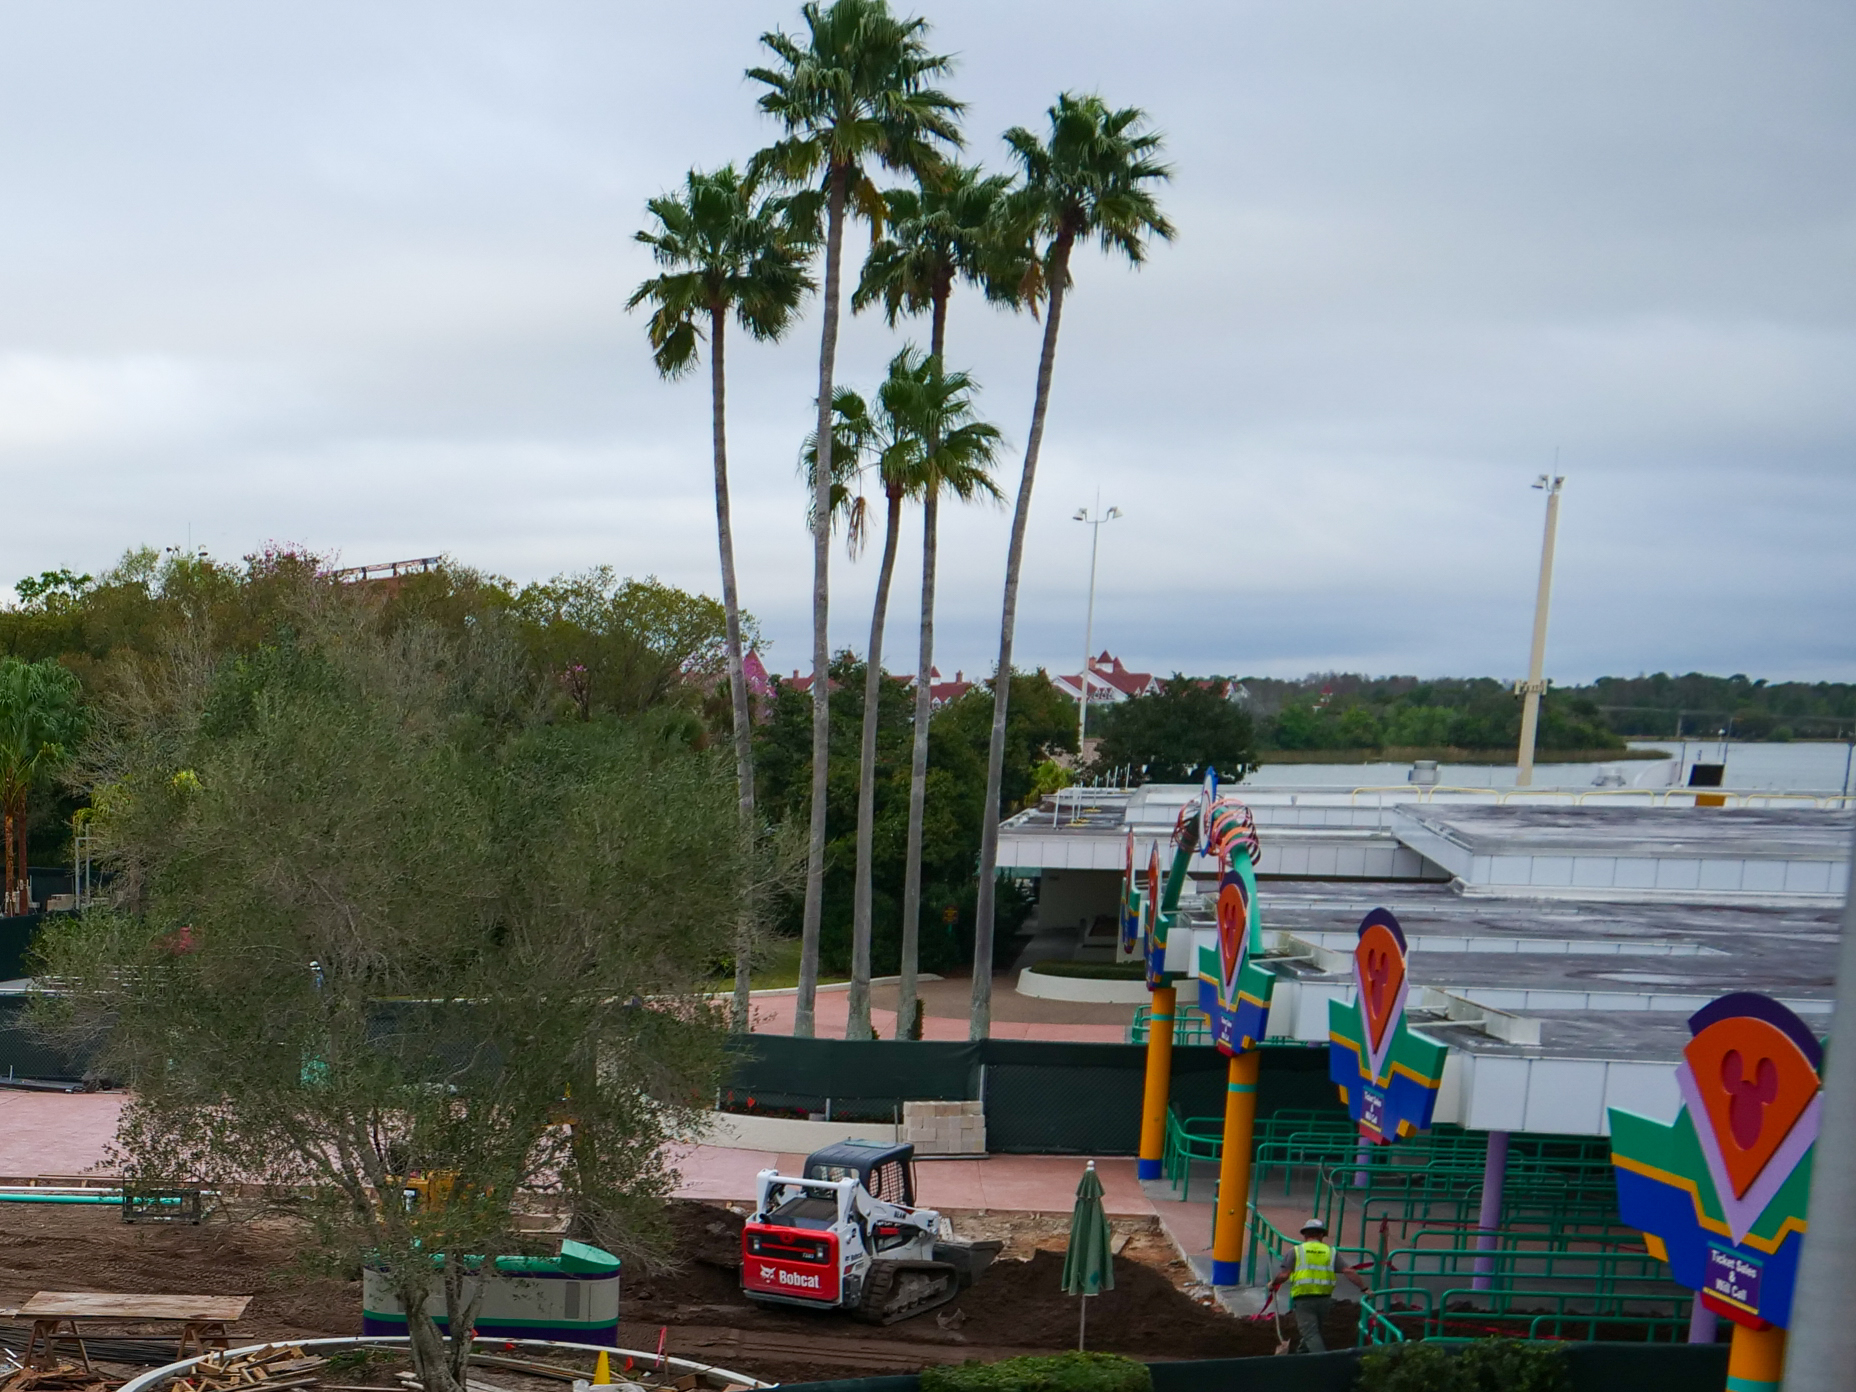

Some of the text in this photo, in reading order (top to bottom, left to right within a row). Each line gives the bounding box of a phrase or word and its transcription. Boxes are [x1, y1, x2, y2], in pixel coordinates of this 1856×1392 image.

[1711, 1249, 1757, 1279] Ticket Sales
[779, 1269, 820, 1289] Bobcat
[1728, 1270, 1736, 1283] &
[1715, 1278, 1747, 1302] Will Call
